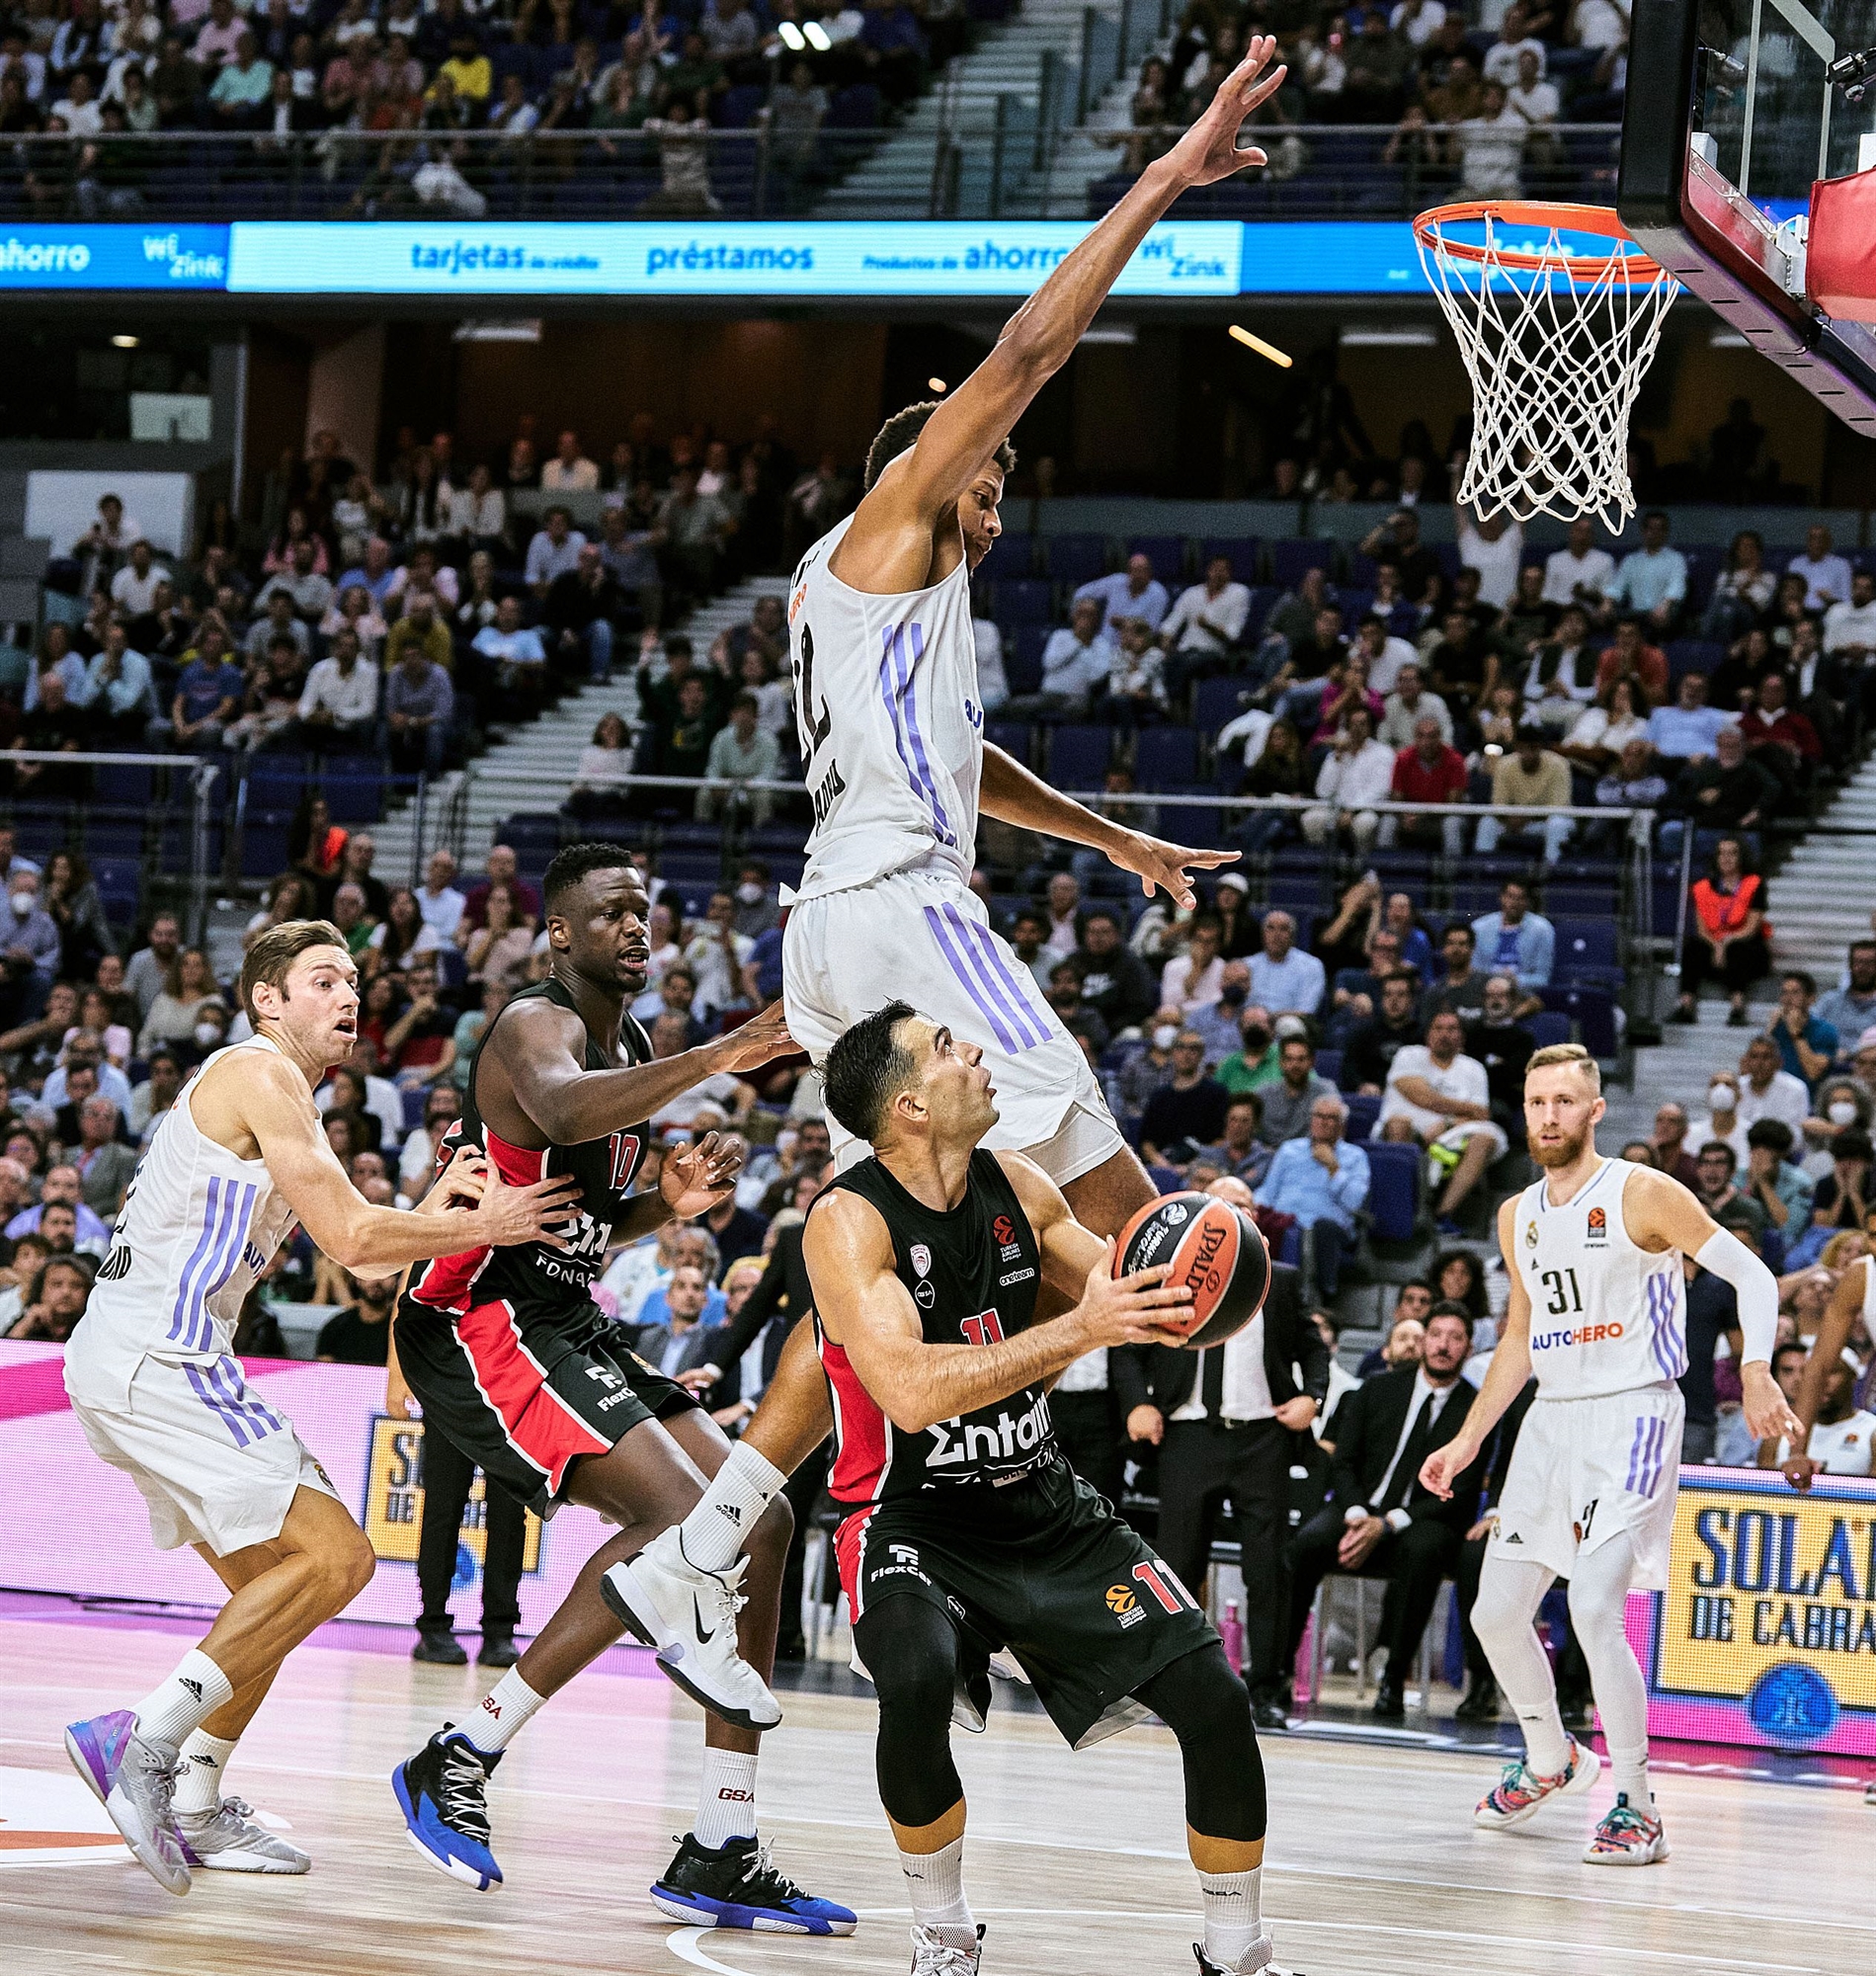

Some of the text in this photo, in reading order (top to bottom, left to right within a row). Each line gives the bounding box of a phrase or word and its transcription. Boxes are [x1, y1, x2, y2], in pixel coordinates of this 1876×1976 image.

[412, 240, 525, 276] tarjetas
[647, 241, 814, 276] préstamos
[609, 1132, 640, 1191] 10
[1541, 1268, 1584, 1315] 31
[1532, 1322, 1624, 1351] AUTOHERO
[1690, 1508, 1876, 1602] SOLA
[1690, 1595, 1734, 1642] DE
[717, 1787, 755, 1804] GSA
